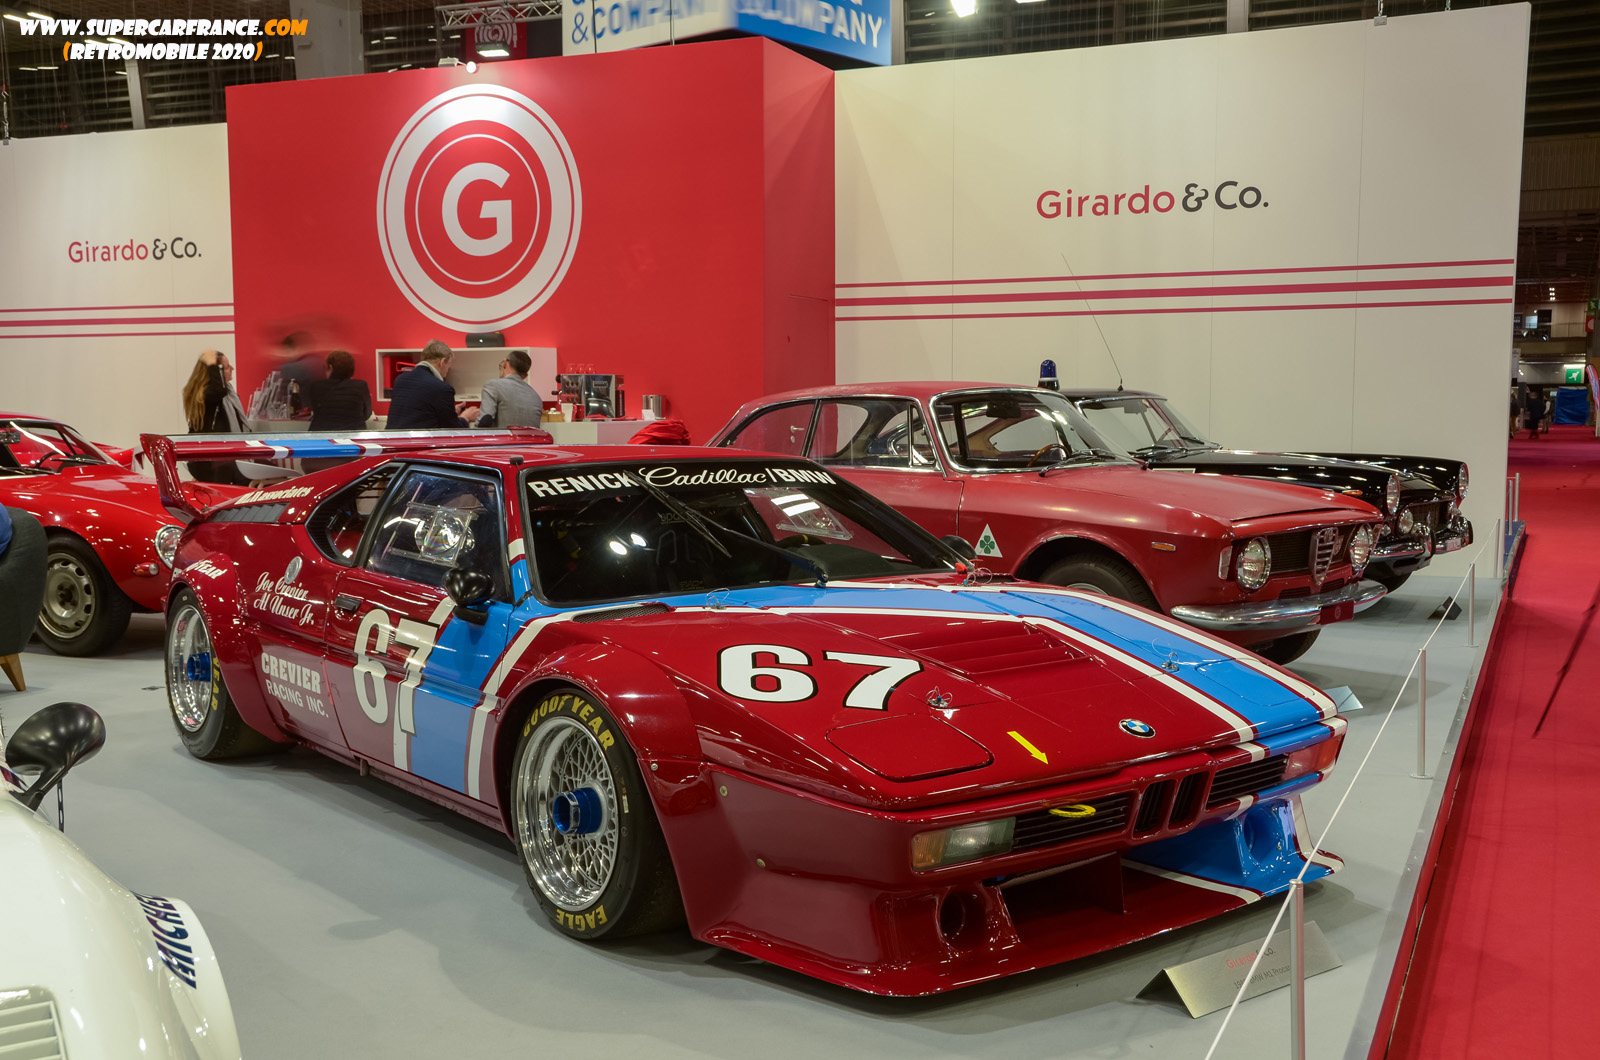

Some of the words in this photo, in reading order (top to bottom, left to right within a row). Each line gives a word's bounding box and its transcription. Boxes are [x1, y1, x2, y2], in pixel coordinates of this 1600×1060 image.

[442, 162, 513, 256] G
[1036, 184, 1175, 219] Girardo
[1215, 180, 1269, 210] Co.
[68, 239, 149, 263] Girardo
[170, 236, 202, 259] Co.
[527, 472, 640, 497] RENICK
[255, 571, 275, 592] Joe
[253, 592, 271, 611] Al
[270, 595, 299, 619] Unser
[261, 652, 321, 694] CREVIER
[353, 606, 441, 738] 67
[717, 644, 925, 711] 67
[265, 679, 303, 707] RACING
[306, 695, 329, 718] INC.
[556, 904, 608, 931] EAGLE
[1226, 952, 1257, 968] Girardo
